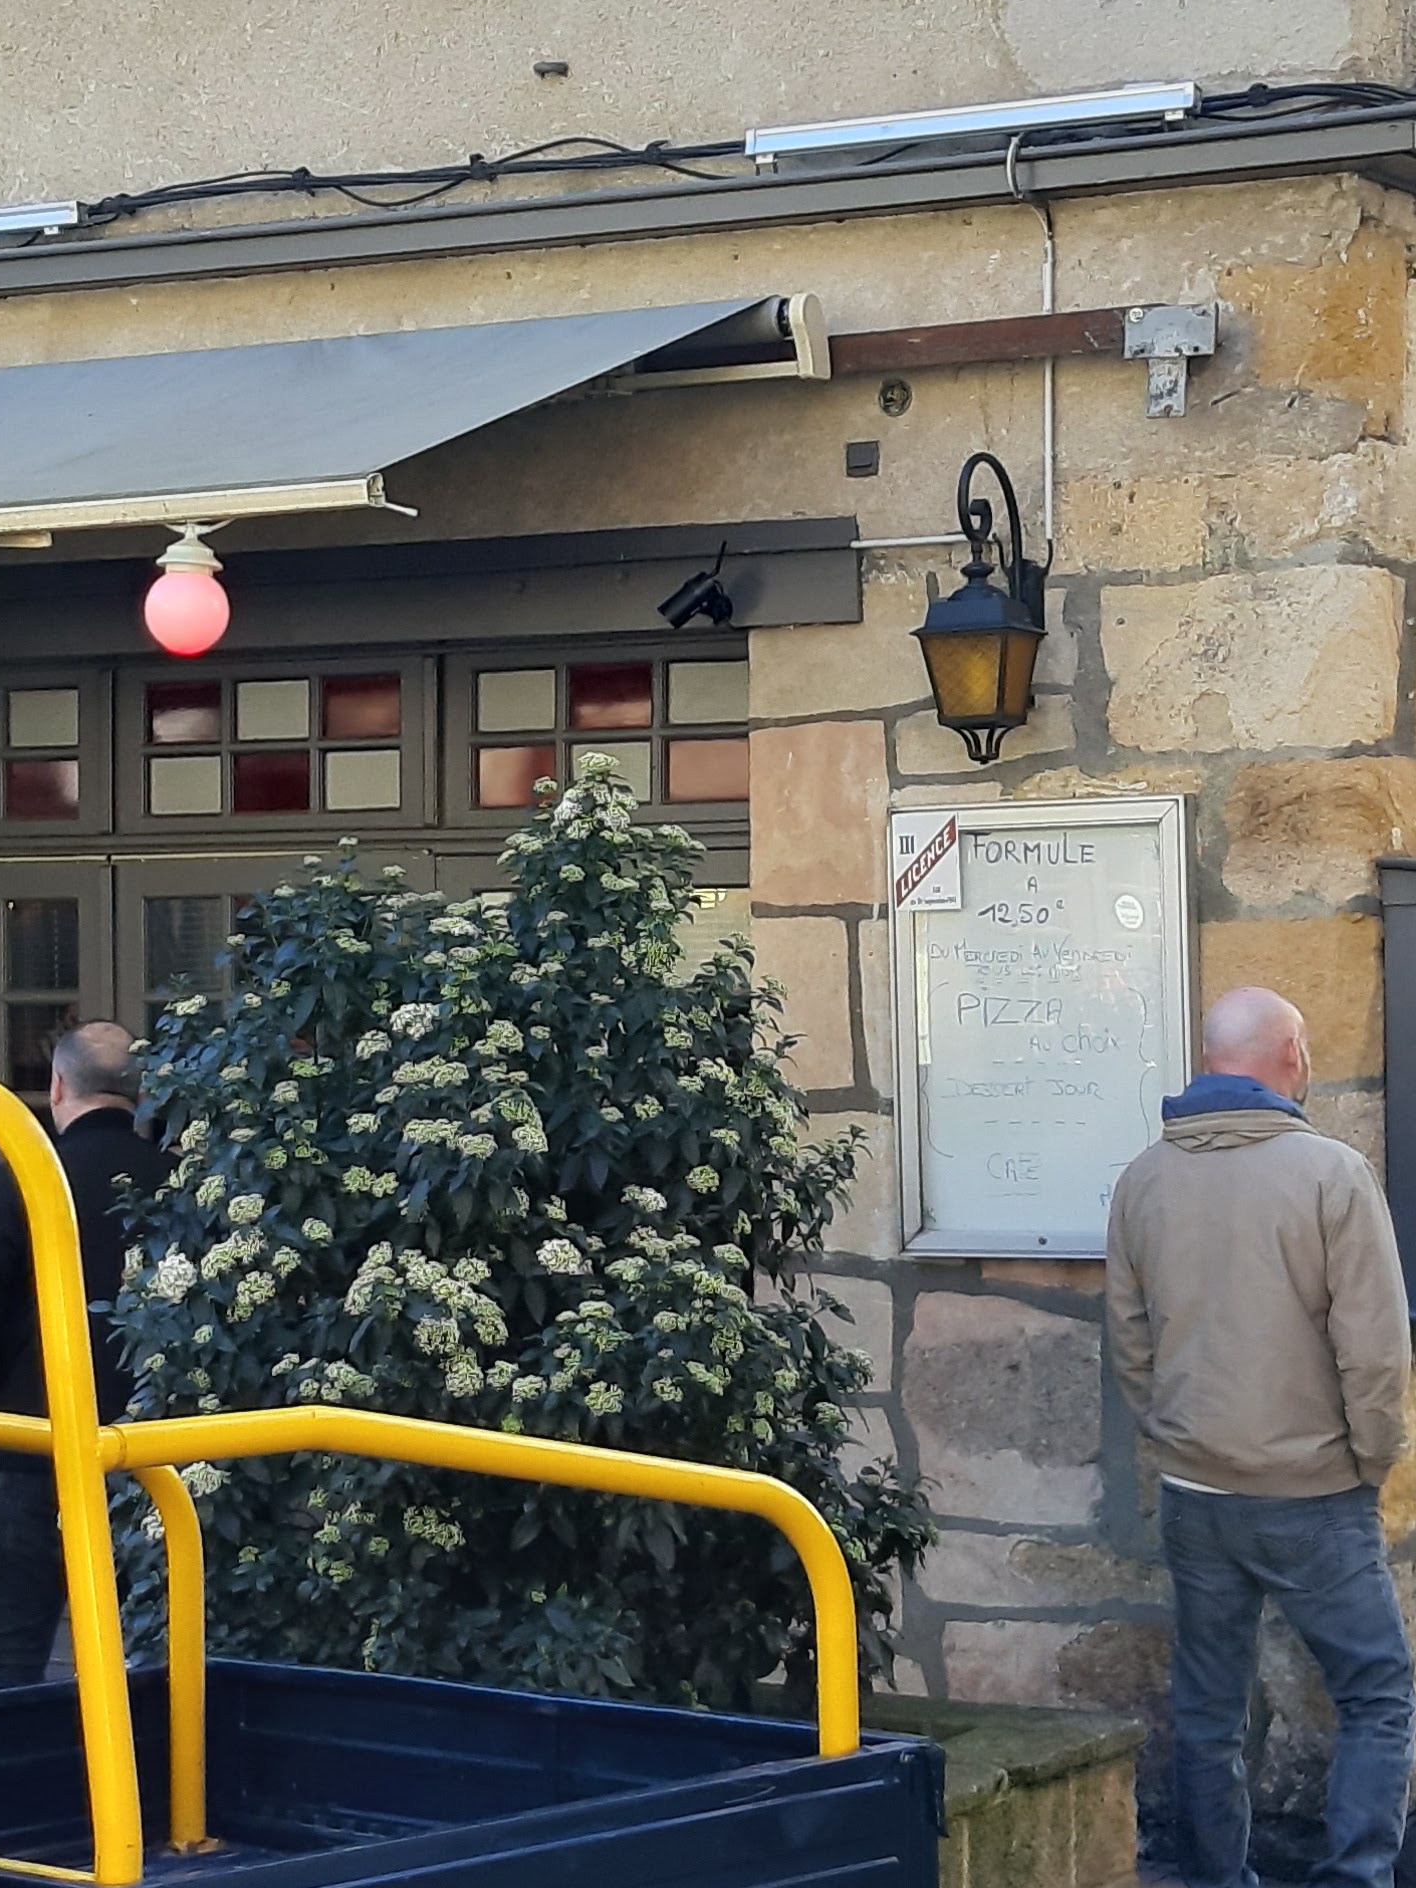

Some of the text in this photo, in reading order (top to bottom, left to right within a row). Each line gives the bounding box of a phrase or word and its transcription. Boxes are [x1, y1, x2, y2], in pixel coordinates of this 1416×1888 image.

[900, 825, 952, 899] LICENCE
[965, 831, 1096, 865] FORMULE
[956, 990, 1062, 1027] PIZZA
